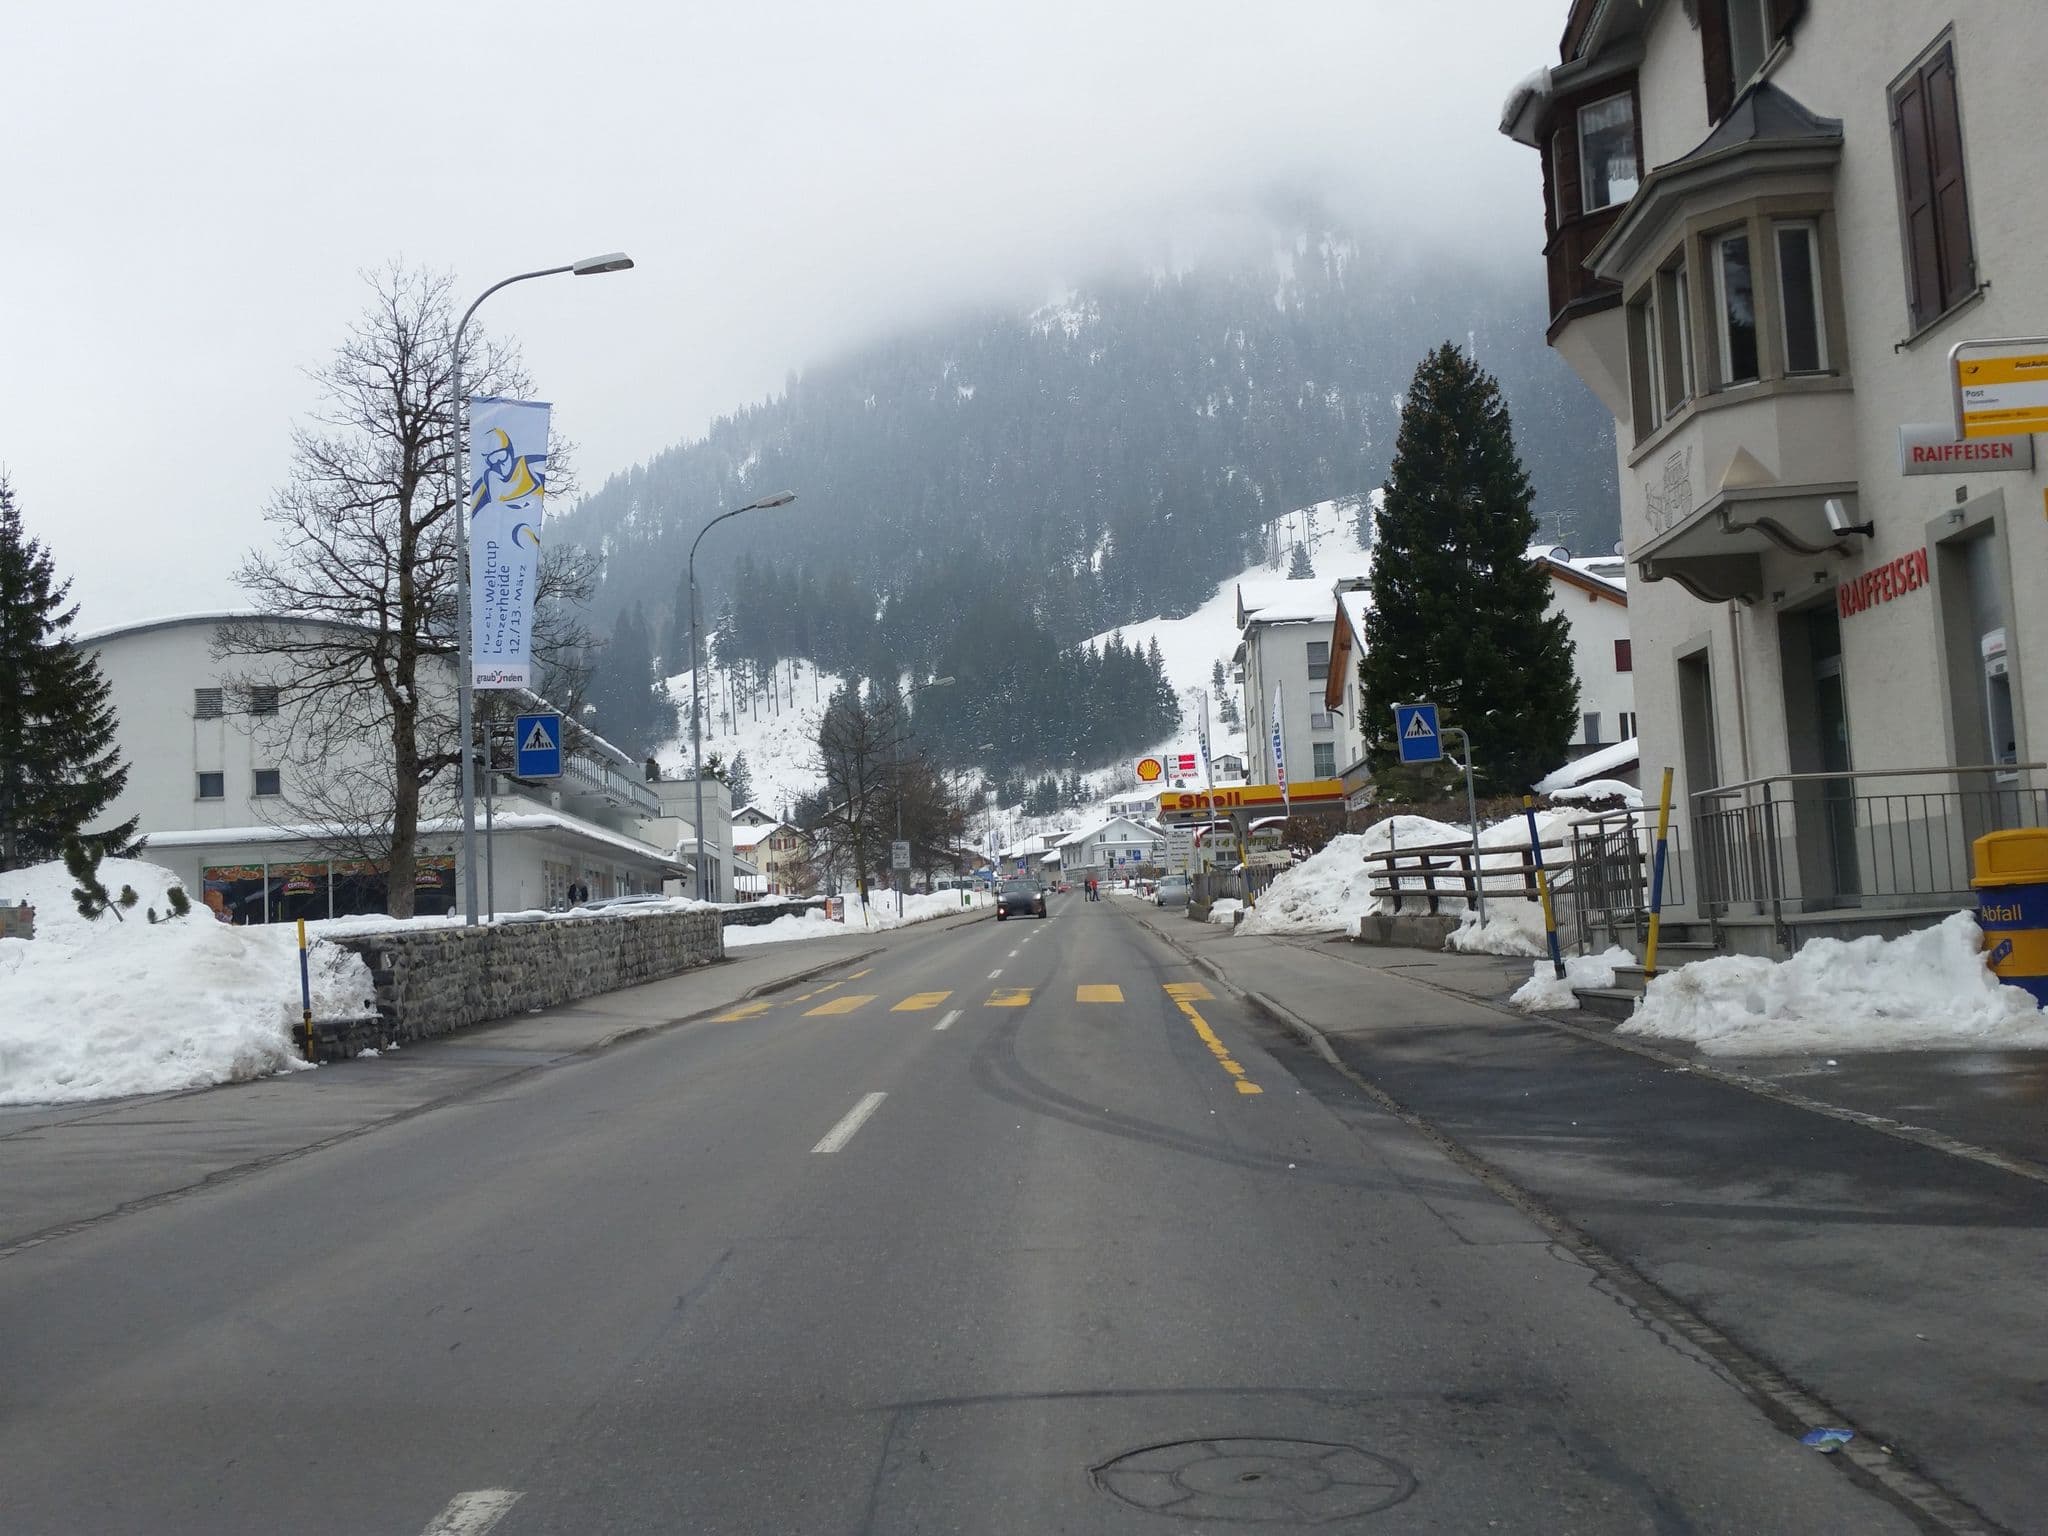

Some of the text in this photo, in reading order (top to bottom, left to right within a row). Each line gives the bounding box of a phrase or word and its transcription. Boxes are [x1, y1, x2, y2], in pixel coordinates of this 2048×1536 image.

[1912, 442, 2014, 464] RAIFFEISEN
[484, 540, 500, 603] Weltcup
[1839, 546, 1930, 619] RAIFFEISEN
[493, 564, 510, 654] Lenzerheide
[1179, 791, 1240, 809] Shell
[1982, 903, 2023, 921] Abfall
